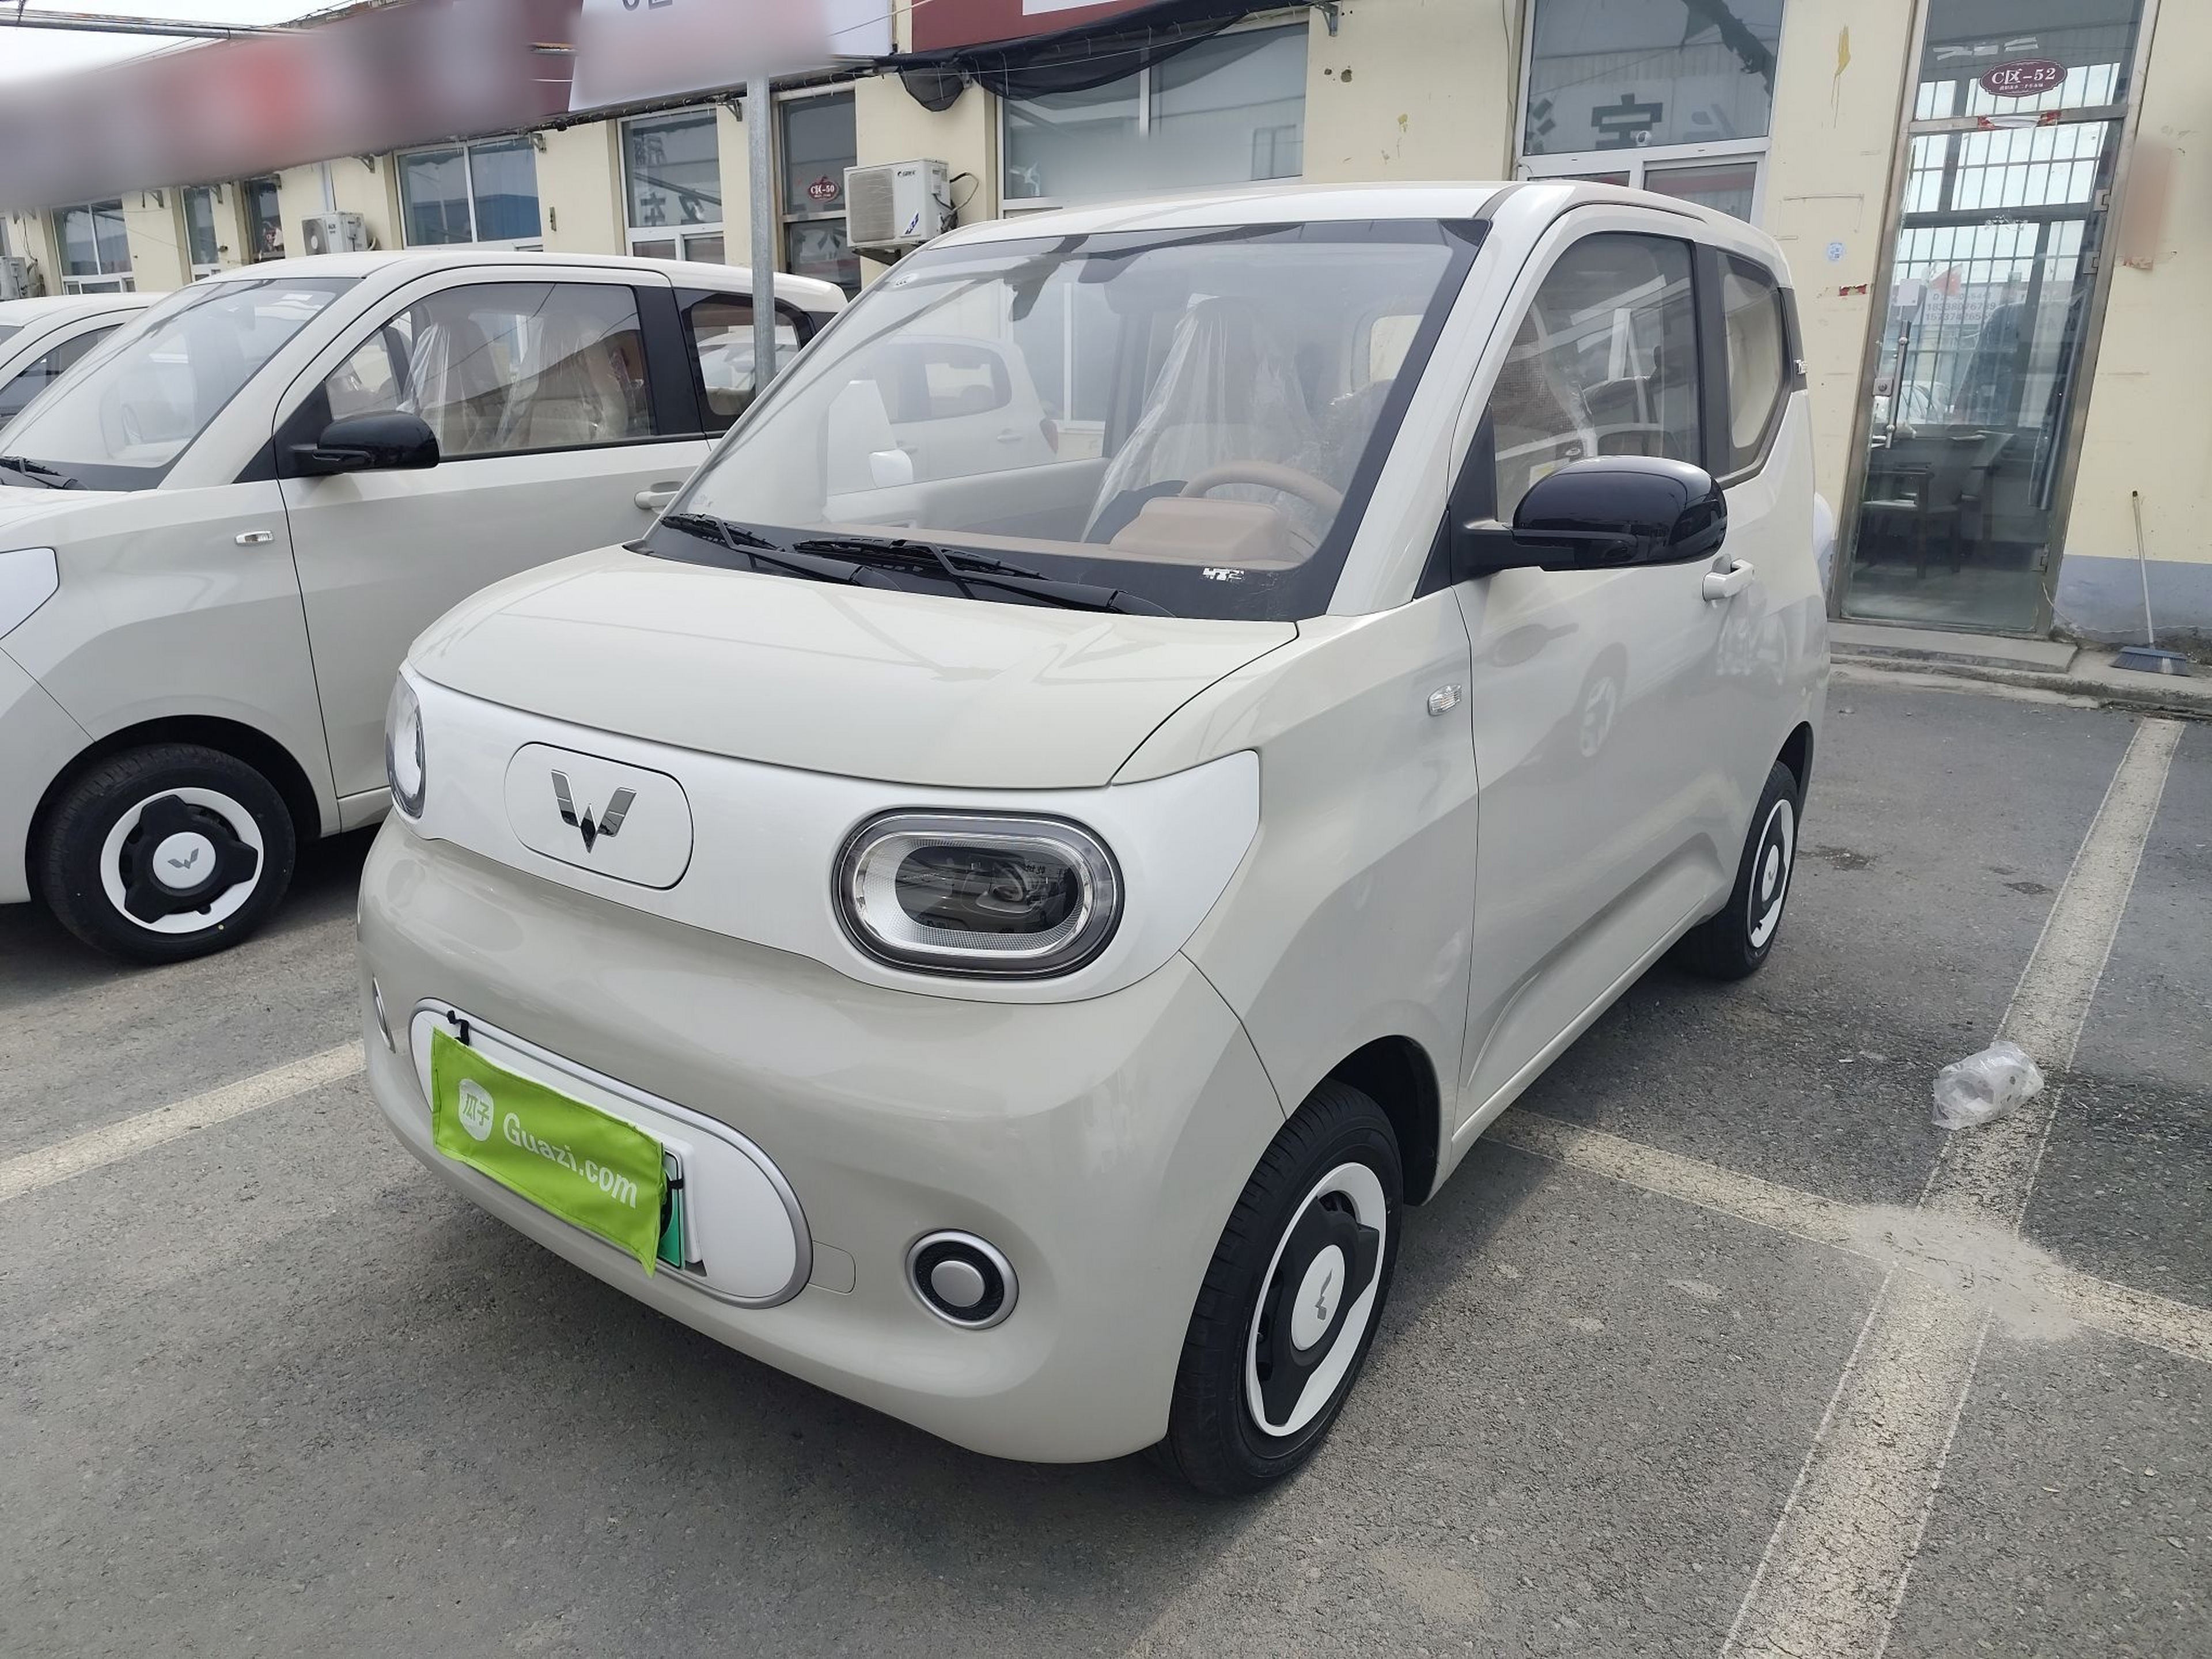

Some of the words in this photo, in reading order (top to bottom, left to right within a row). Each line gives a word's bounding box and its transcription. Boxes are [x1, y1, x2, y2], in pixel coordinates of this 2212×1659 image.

[1991, 67, 2056, 85] C区-52
[463, 1092, 490, 1126] 瓜子
[503, 1112, 638, 1209] Guazi.com
